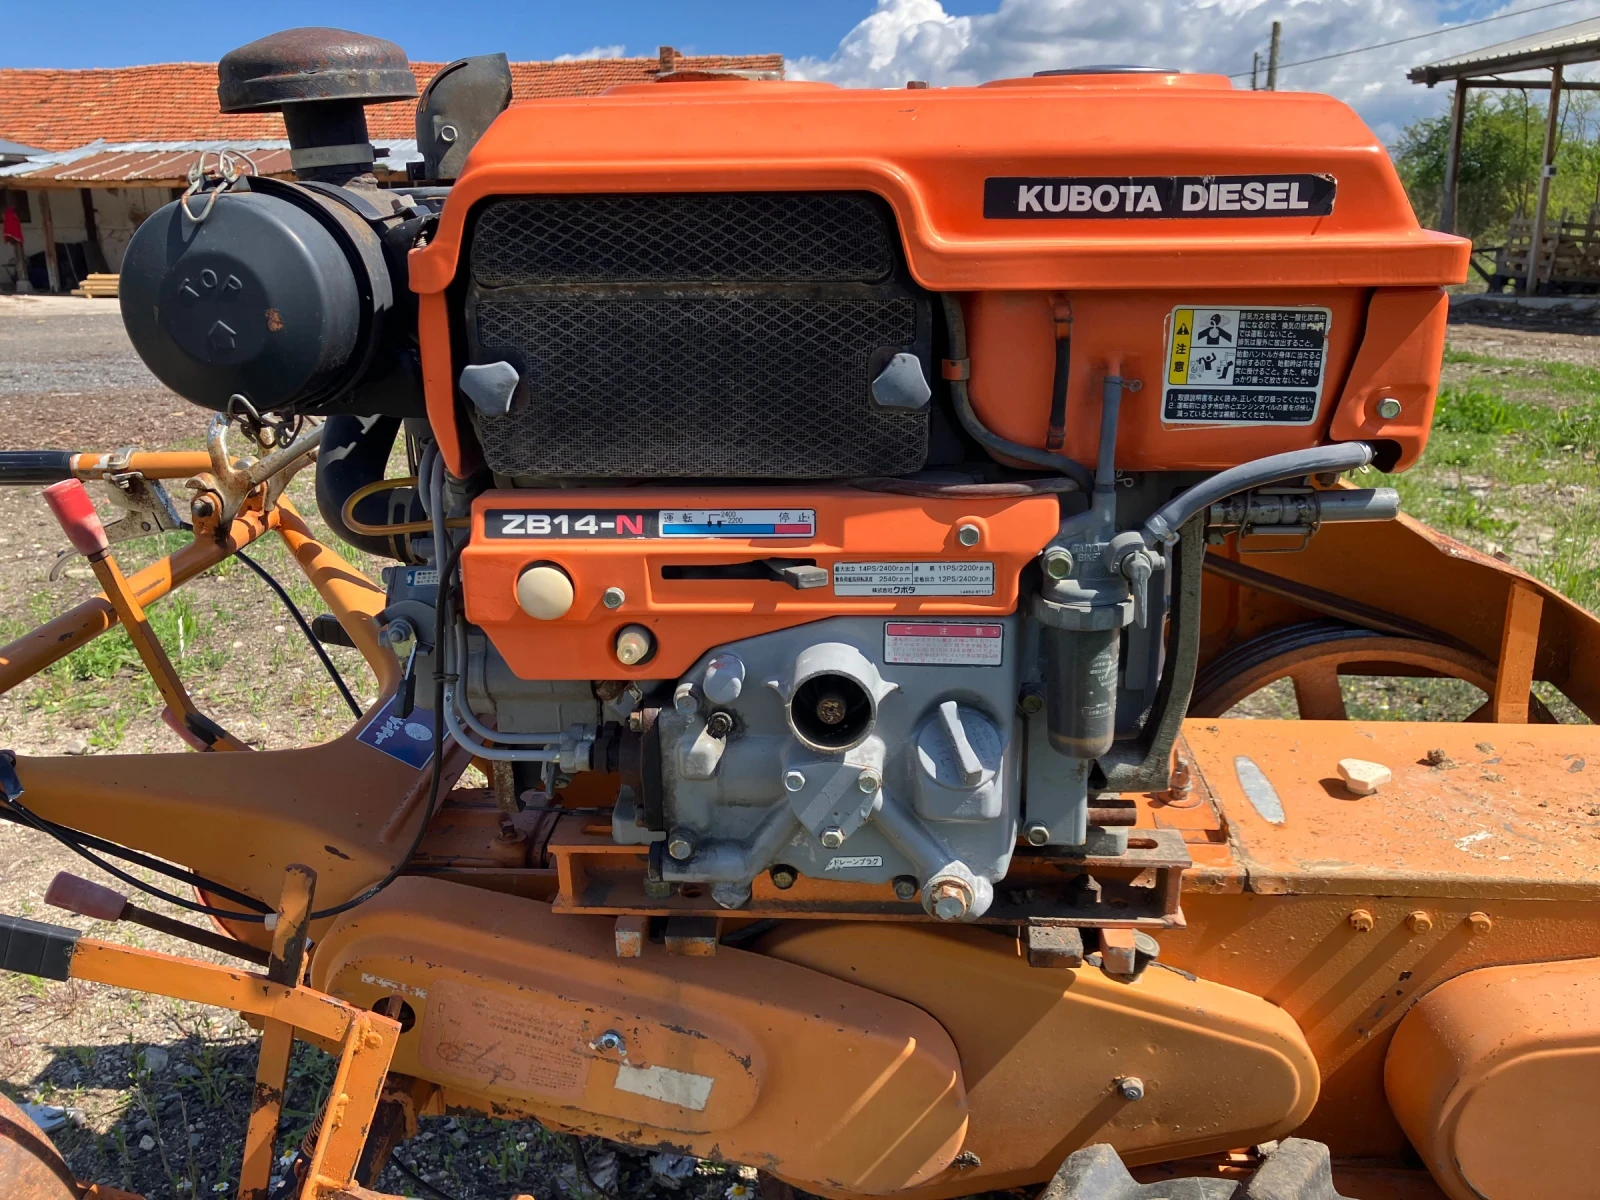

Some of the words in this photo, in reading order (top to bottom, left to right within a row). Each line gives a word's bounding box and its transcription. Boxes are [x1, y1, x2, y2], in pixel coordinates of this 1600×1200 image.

[1018, 184, 1162, 213] KUBOTA
[1183, 181, 1309, 211] DIESEL
[178, 268, 243, 297] TOP
[1173, 343, 1187, 372] 注意
[501, 514, 643, 535] ZB14-N
[663, 512, 693, 523] 運転
[778, 512, 808, 523] 停止
